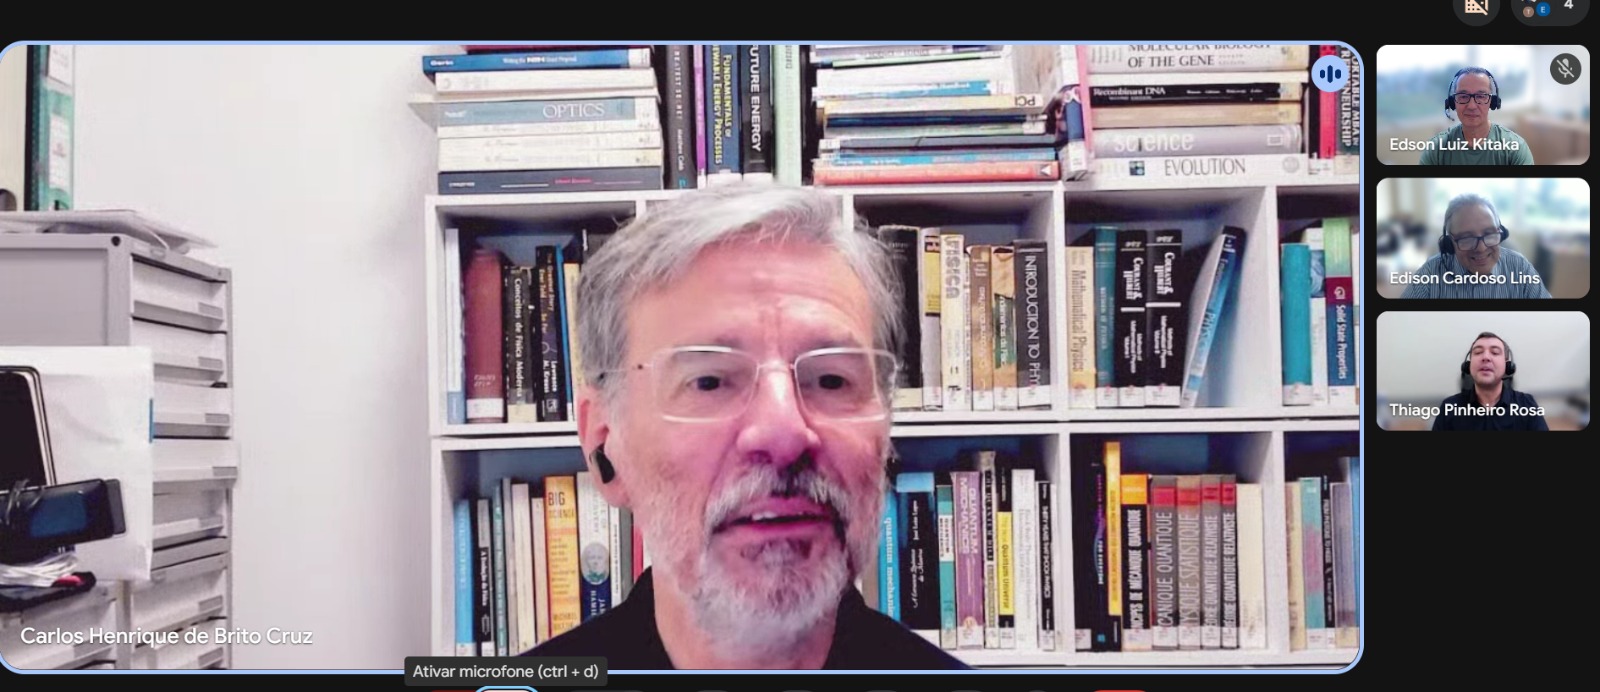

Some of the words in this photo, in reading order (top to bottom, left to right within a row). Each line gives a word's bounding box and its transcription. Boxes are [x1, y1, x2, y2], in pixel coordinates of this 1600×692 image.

[1128, 56, 1143, 68] OF
[1145, 55, 1175, 67] THE
[1180, 55, 1214, 66] GENE
[713, 84, 723, 116] ENERGY
[724, 55, 732, 127] FUNDAMENTALS
[1093, 88, 1143, 96] Recombinant
[1145, 87, 1166, 95] DNA
[542, 103, 605, 119] OPTICS
[751, 96, 761, 152] ENERGY
[1352, 110, 1360, 136] MBA
[714, 119, 723, 164] PROCESSES
[1113, 134, 1195, 153] science
[1164, 158, 1246, 177] EVOLUTION
[1132, 257, 1144, 292] COURANT
[1164, 252, 1175, 287] COURANT
[514, 278, 524, 318] Conceitos
[1025, 255, 1038, 339] INTRODUCTION
[1072, 270, 1086, 333] Mathematical
[1336, 304, 1346, 322] Solid
[515, 322, 522, 333] de
[1336, 324, 1347, 342] State
[543, 360, 549, 369] M.
[1028, 344, 1039, 358] TO
[1072, 336, 1087, 372] Physics
[1336, 343, 1348, 379] Properties
[548, 492, 566, 506] BIG
[959, 477, 969, 554] MECHANICS
[969, 488, 978, 554] QUANTUM
[1127, 509, 1142, 547] QUANTIQUE
[1204, 516, 1217, 558] RELATIVISTE
[1222, 512, 1235, 555] RELATIVISTE
[883, 517, 894, 563] quantum
[1155, 512, 1173, 573] QUANTIQUE
[1178, 513, 1199, 579] STATISTIQUE
[1001, 544, 1009, 577] Quantum
[1127, 550, 1143, 589] MÉCANIQUE
[1002, 578, 1011, 609] Universe
[1129, 592, 1143, 600] DE
[1204, 561, 1218, 604] QUANTIQUE
[1223, 557, 1236, 601] QUANTIQUE
[1157, 577, 1174, 626] CANIQUE
